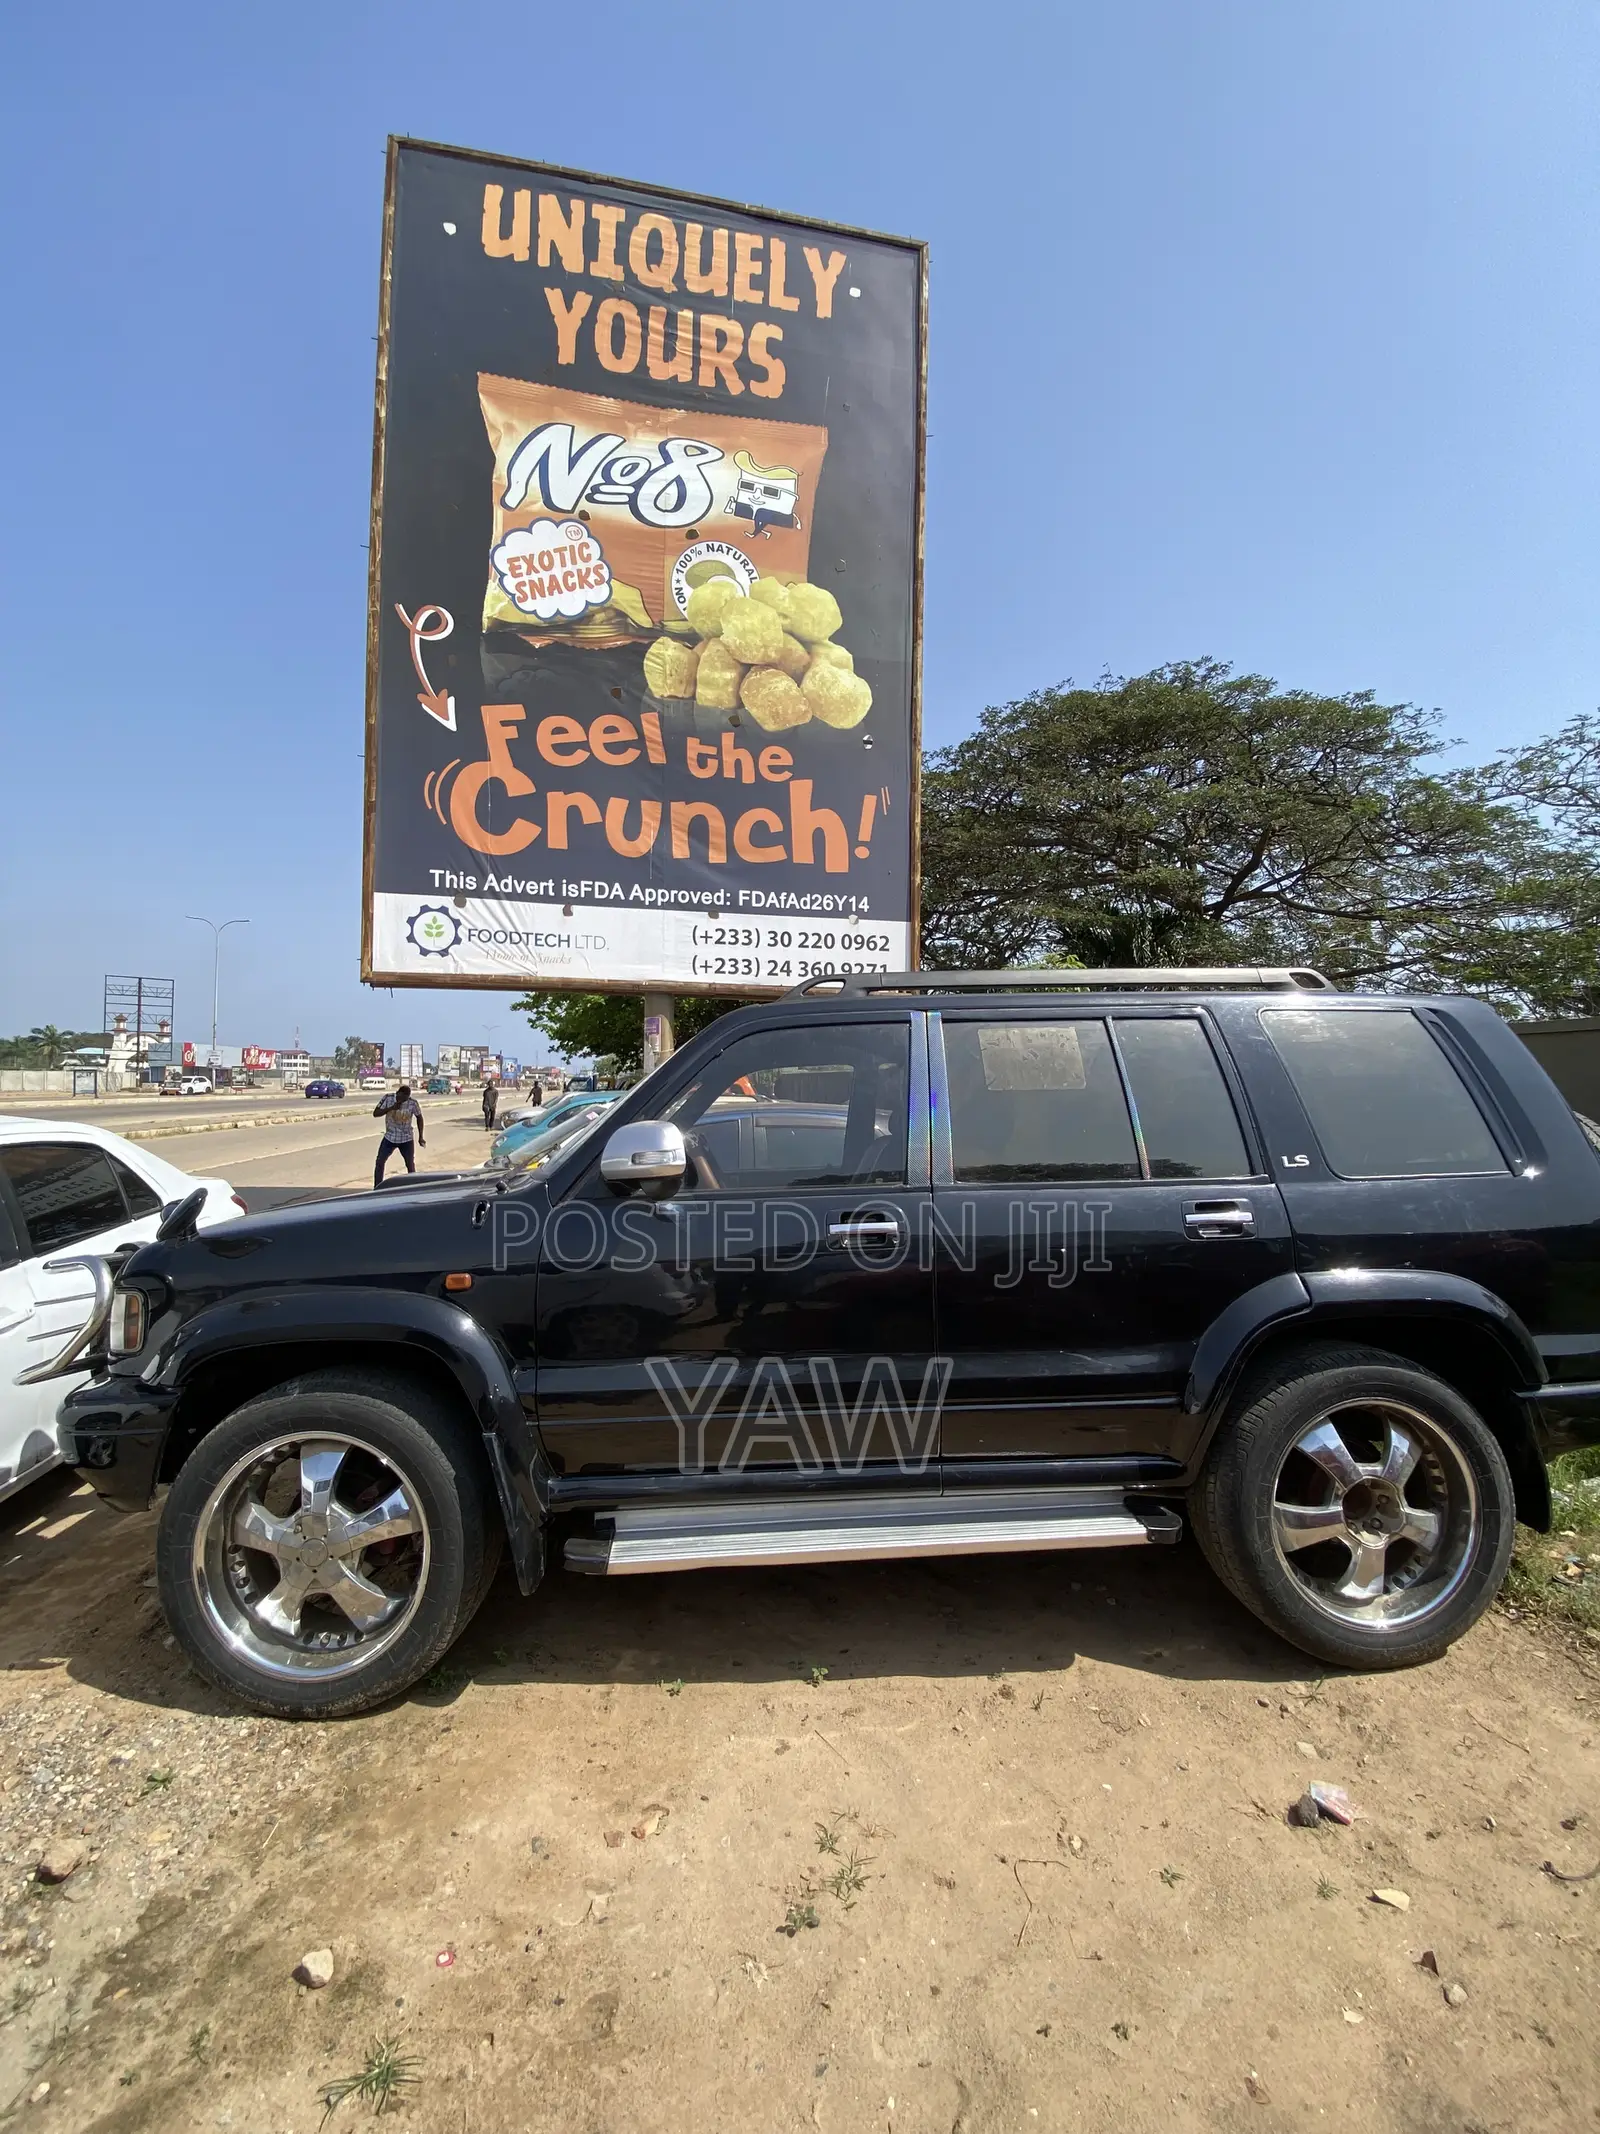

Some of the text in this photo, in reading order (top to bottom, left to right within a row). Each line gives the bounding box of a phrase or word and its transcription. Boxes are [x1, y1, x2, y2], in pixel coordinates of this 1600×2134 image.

[481, 184, 846, 319] UNIQUELY
[544, 287, 786, 399] YOURS
[506, 543, 592, 579] EXOTIC
[675, 543, 760, 584] 100% NATURAL
[514, 564, 606, 604] SNACKS
[480, 702, 794, 784] Feel the
[449, 761, 877, 873] Crunch!
[429, 869, 477, 891] This
[483, 872, 555, 898] Advert
[630, 883, 732, 909] Approved:
[738, 889, 870, 913] FDAfAd26Y14
[468, 928, 610, 950] FOODTECH LTD.
[692, 925, 890, 952] (+233) 30 220 0962
[692, 955, 761, 978] (+233)
[767, 960, 792, 977] 24
[798, 961, 835, 978] 360
[1281, 1154, 1310, 1168] LS
